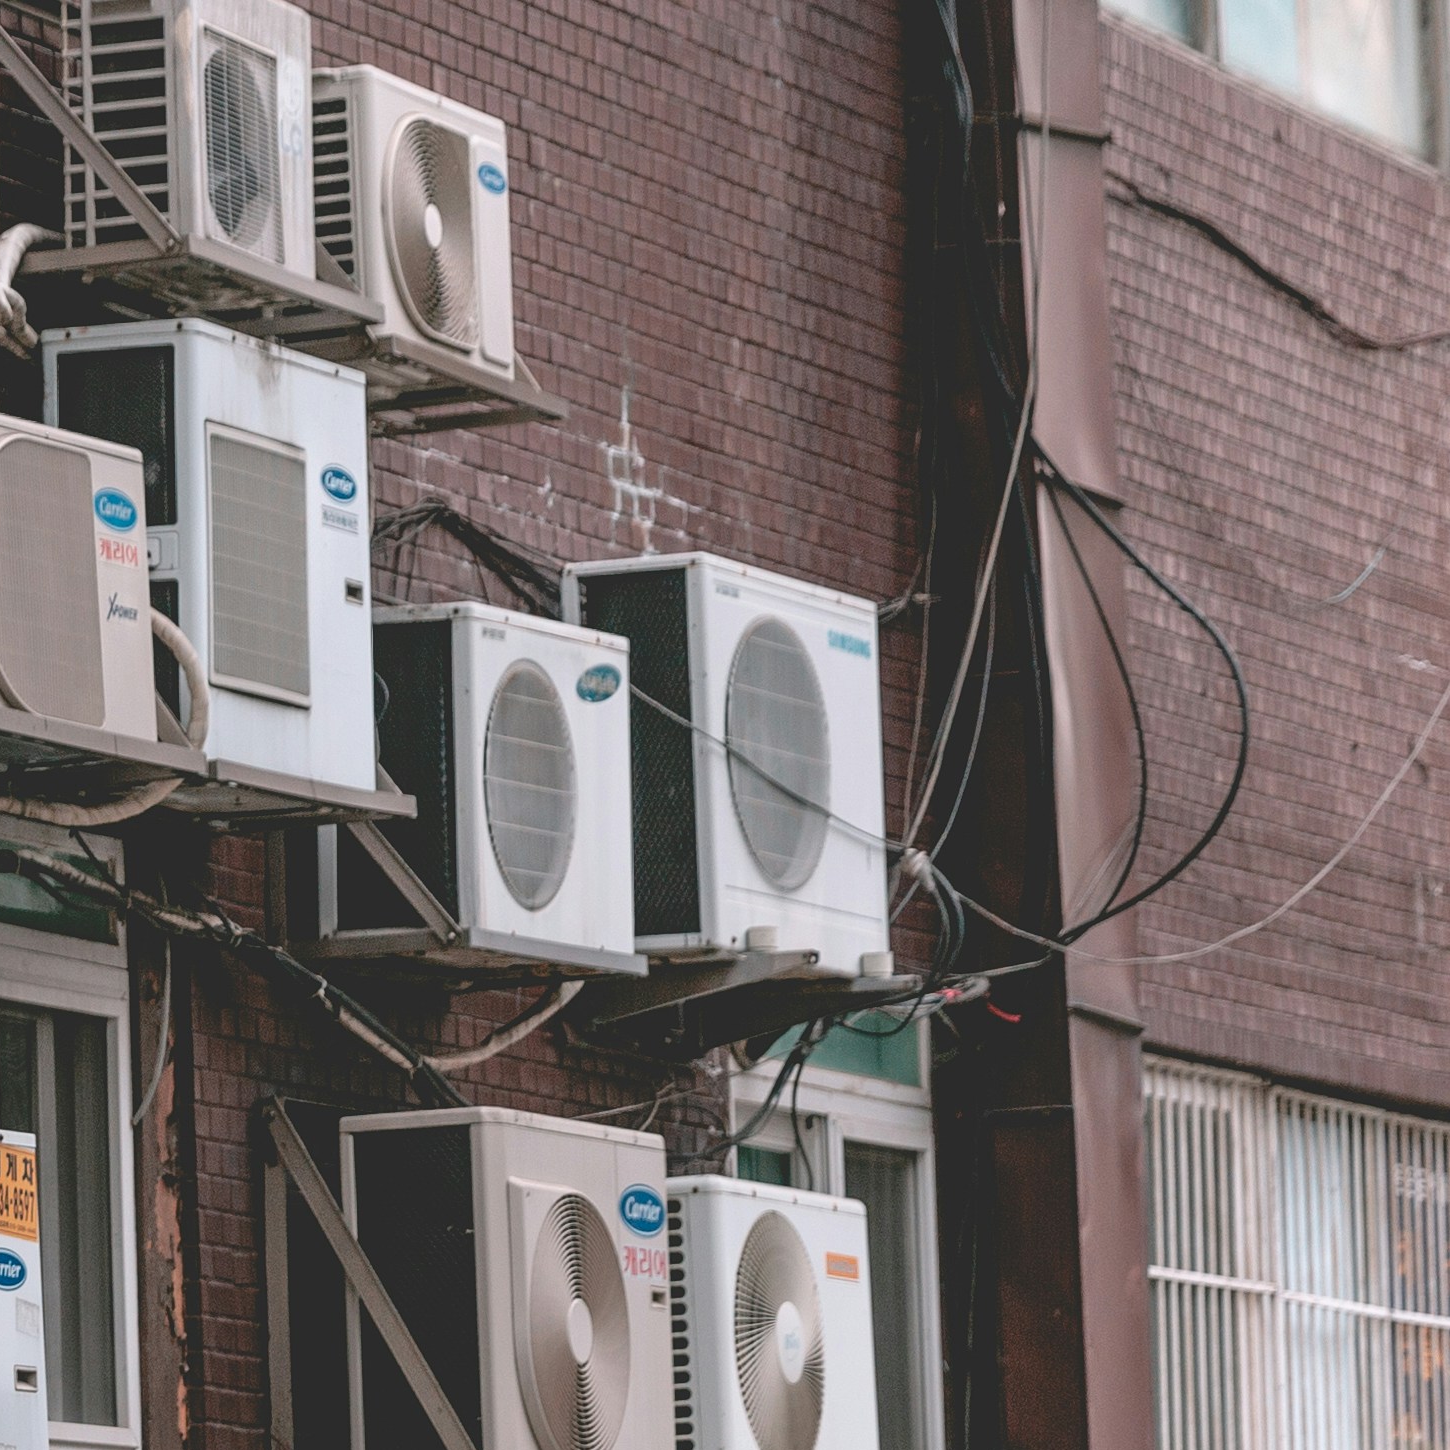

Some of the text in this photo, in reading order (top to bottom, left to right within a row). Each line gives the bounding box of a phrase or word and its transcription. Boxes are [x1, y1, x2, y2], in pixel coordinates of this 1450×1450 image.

[323, 470, 354, 494] Carrier
[98, 496, 132, 521] Carrier
[99, 537, 139, 567] 캐리어
[624, 1195, 661, 1223] Carrier
[623, 1245, 667, 1280] 캐리어
